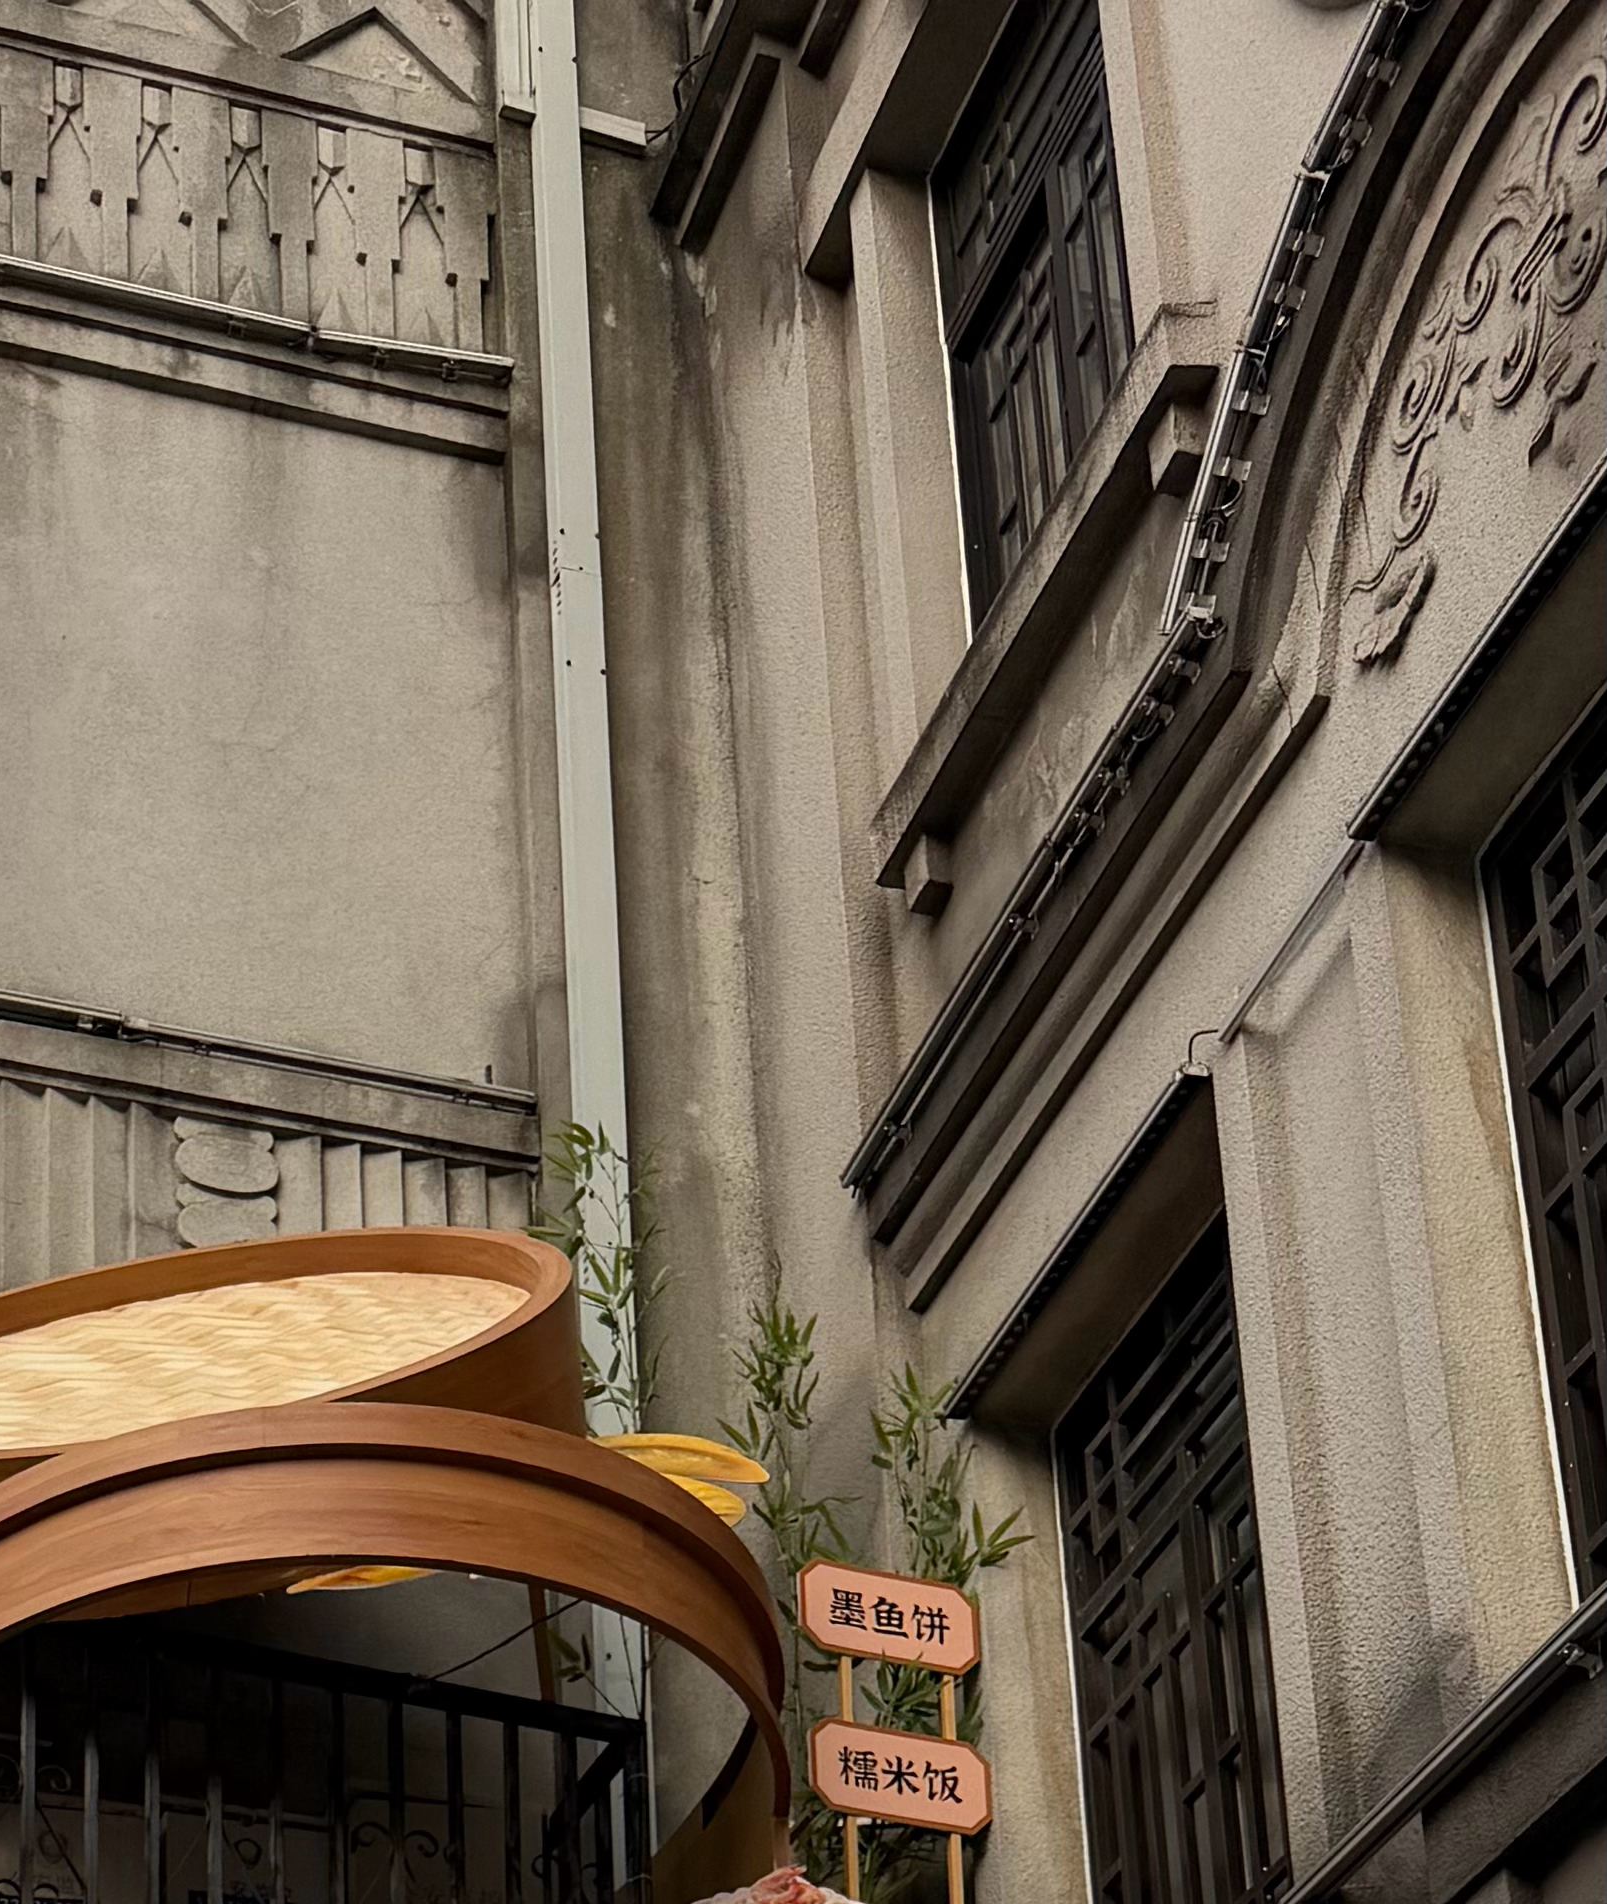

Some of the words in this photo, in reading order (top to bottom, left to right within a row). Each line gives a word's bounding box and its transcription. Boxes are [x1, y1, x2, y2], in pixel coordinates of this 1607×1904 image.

[829, 1587, 951, 1645] 墨鱼饼
[837, 1745, 964, 1804] 糯米饭
